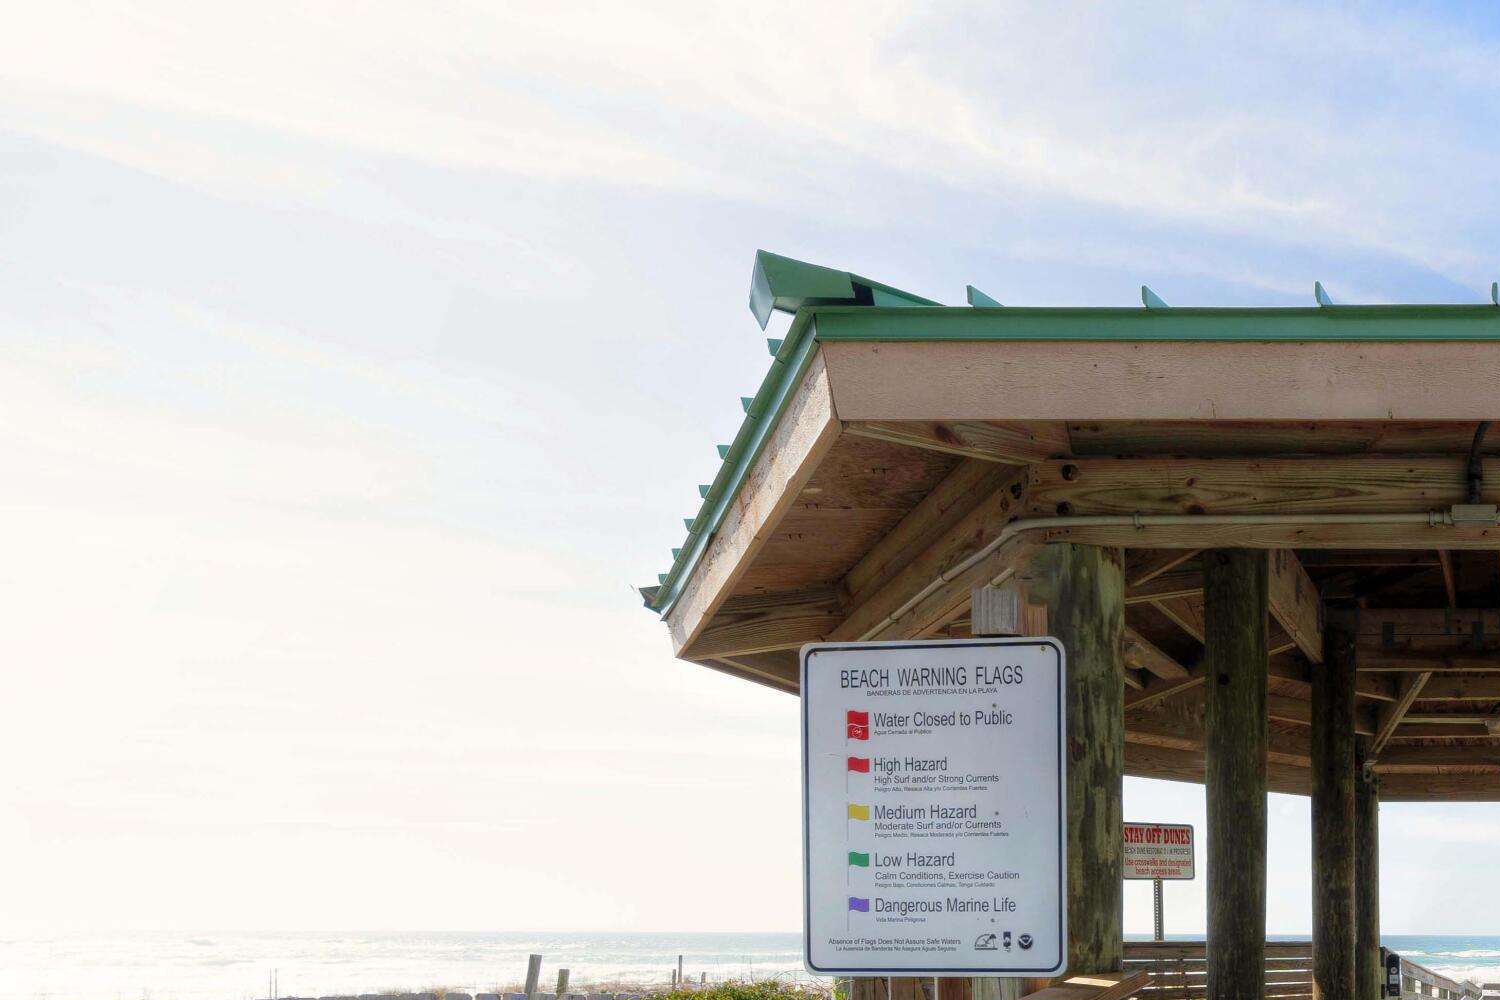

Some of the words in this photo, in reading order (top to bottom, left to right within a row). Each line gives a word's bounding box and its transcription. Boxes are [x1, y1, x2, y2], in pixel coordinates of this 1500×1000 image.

[840, 669, 889, 688] BEACH
[897, 667, 967, 687] WARNING
[976, 666, 1023, 685] FLAGS
[874, 712, 910, 727] Water
[913, 711, 955, 726] Closed
[960, 712, 970, 726] to
[975, 710, 1013, 725] Public
[874, 758, 900, 775] High
[905, 756, 947, 771] Hazard
[874, 776, 891, 786] High
[894, 775, 909, 784] Surf
[912, 775, 936, 784] and/or
[938, 774, 964, 784] Strong
[966, 774, 999, 782] Currents
[874, 805, 925, 819] Medium
[930, 804, 977, 819] Hazard
[874, 822, 914, 830] Moderate
[916, 822, 933, 830] Surf
[936, 821, 963, 829] and/or
[966, 820, 1002, 829] Currents
[1124, 827, 1144, 843] STAY
[1146, 828, 1161, 843] OFF
[1164, 828, 1190, 844] DUNES
[875, 852, 902, 867] Low
[907, 852, 955, 866] Hazard
[875, 872, 896, 880] Calm
[900, 872, 946, 881] Conditions,
[948, 871, 985, 880] Exercise
[987, 871, 1019, 879] Caution
[875, 898, 942, 916] Dangerous
[947, 898, 989, 912] Marine
[994, 897, 1016, 912] Life
